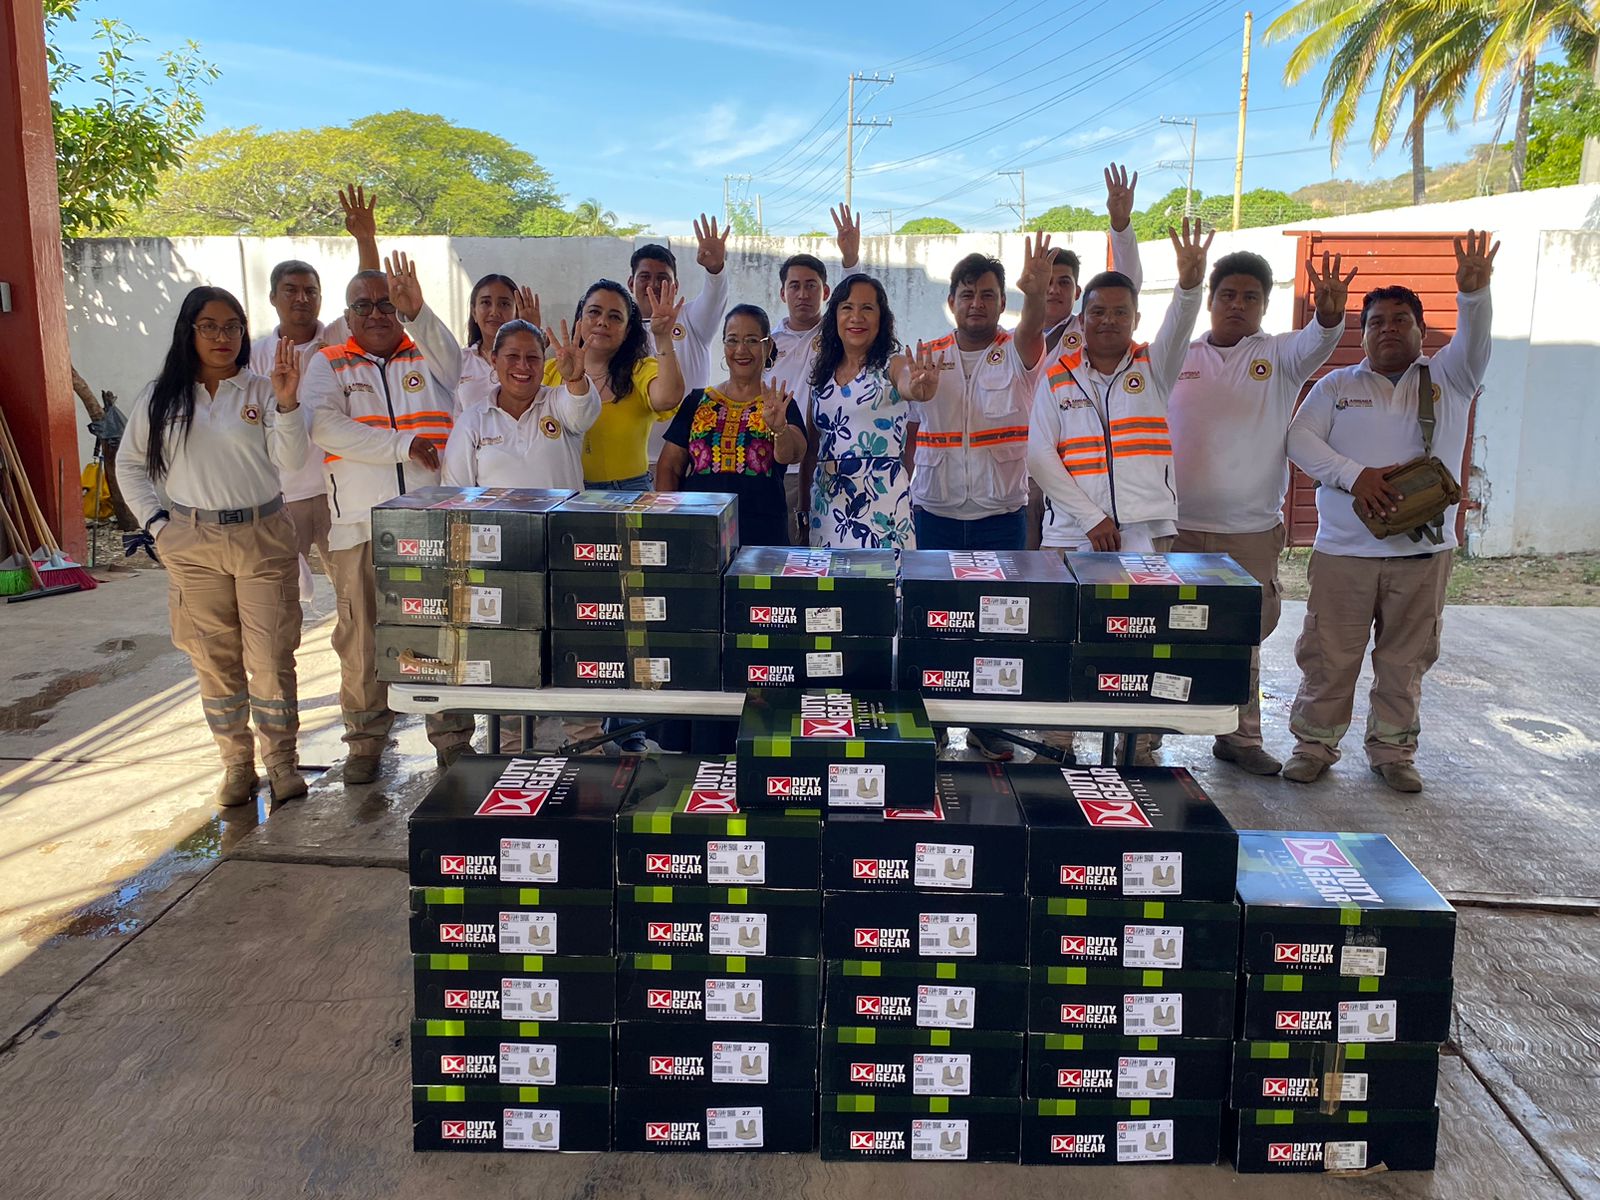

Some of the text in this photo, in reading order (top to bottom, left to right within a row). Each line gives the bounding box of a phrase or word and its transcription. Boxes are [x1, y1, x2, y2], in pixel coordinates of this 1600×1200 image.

[419, 539, 444, 548] DUTY
[597, 544, 622, 552] DUTY
[419, 548, 445, 556] GEAR
[597, 552, 622, 561] GEAR
[423, 599, 447, 607] DUTY
[599, 604, 624, 612] DUTY
[423, 606, 448, 615] GEAR
[598, 611, 624, 620] GEAR
[772, 607, 796, 616] DUTY
[950, 611, 974, 620] DUTY
[772, 615, 797, 624] GEAR
[950, 619, 975, 628] GEAR
[1130, 617, 1155, 626] DUTY
[1130, 625, 1156, 634] GEAR
[599, 662, 624, 670] DUTY
[769, 666, 794, 674] DUTY
[598, 670, 624, 678] GEAR
[768, 673, 794, 682] GEAR
[945, 671, 969, 679] DUTY
[1121, 674, 1148, 683] DUTY
[944, 679, 970, 688] GEAR
[1121, 682, 1149, 691] GEAR
[801, 694, 827, 719] DUTY
[827, 693, 853, 719] GEAR
[494, 757, 539, 788] DUTY
[524, 757, 568, 789] GEAR
[692, 760, 725, 790] DUTY
[792, 777, 820, 786] DUTY
[1060, 767, 1103, 799] DUTY
[1090, 767, 1135, 800] GEAR
[792, 786, 822, 796] GEAR
[466, 856, 495, 865] DUTY
[672, 854, 701, 864] DUTY
[879, 859, 908, 869] DUTY
[466, 864, 497, 874] GEAR
[672, 864, 702, 874] GEAR
[878, 868, 909, 879] GEAR
[1087, 866, 1116, 876] DUTY
[1086, 875, 1117, 885] GEAR
[1302, 868, 1352, 902] GEAR
[1330, 868, 1384, 903] DUTY
[465, 924, 494, 934] DUTY
[673, 923, 702, 932] DUTY
[464, 933, 496, 942] GEAR
[672, 932, 703, 942] GEAR
[880, 928, 909, 938] DUTY
[880, 938, 910, 948] GEAR
[1087, 936, 1116, 946] DUTY
[1086, 946, 1118, 956] GEAR
[1302, 944, 1334, 954] DUTY
[1302, 953, 1333, 963] GEAR
[470, 990, 498, 1000] DUTY
[673, 990, 701, 1000] DUTY
[470, 999, 500, 1009] GEAR
[672, 999, 702, 1010] GEAR
[881, 996, 910, 1006] DUTY
[880, 1006, 911, 1016] GEAR
[1087, 1005, 1116, 1014] DUTY
[1086, 1014, 1117, 1024] GEAR
[1301, 1011, 1331, 1020] DUTY
[1300, 1020, 1332, 1030] GEAR
[466, 1055, 495, 1064] DUTY
[675, 1057, 703, 1066] DUTY
[466, 1064, 496, 1073] GEAR
[674, 1066, 704, 1075] GEAR
[876, 1064, 905, 1073] DUTY
[1083, 1069, 1112, 1078] DUTY
[876, 1072, 906, 1083] GEAR
[1082, 1078, 1113, 1088] GEAR
[1289, 1078, 1318, 1088] DUTY
[1288, 1087, 1318, 1096] GEAR
[466, 1121, 495, 1130] DUTY
[671, 1122, 699, 1132] DUTY
[466, 1129, 496, 1139] GEAR
[671, 1131, 700, 1141] GEAR
[876, 1131, 904, 1140] DUTY
[1076, 1134, 1104, 1144] DUTY
[876, 1140, 905, 1150] GEAR
[1076, 1143, 1105, 1152] GEAR
[1294, 1142, 1322, 1152] DUTY
[1293, 1151, 1322, 1161] GEAR
